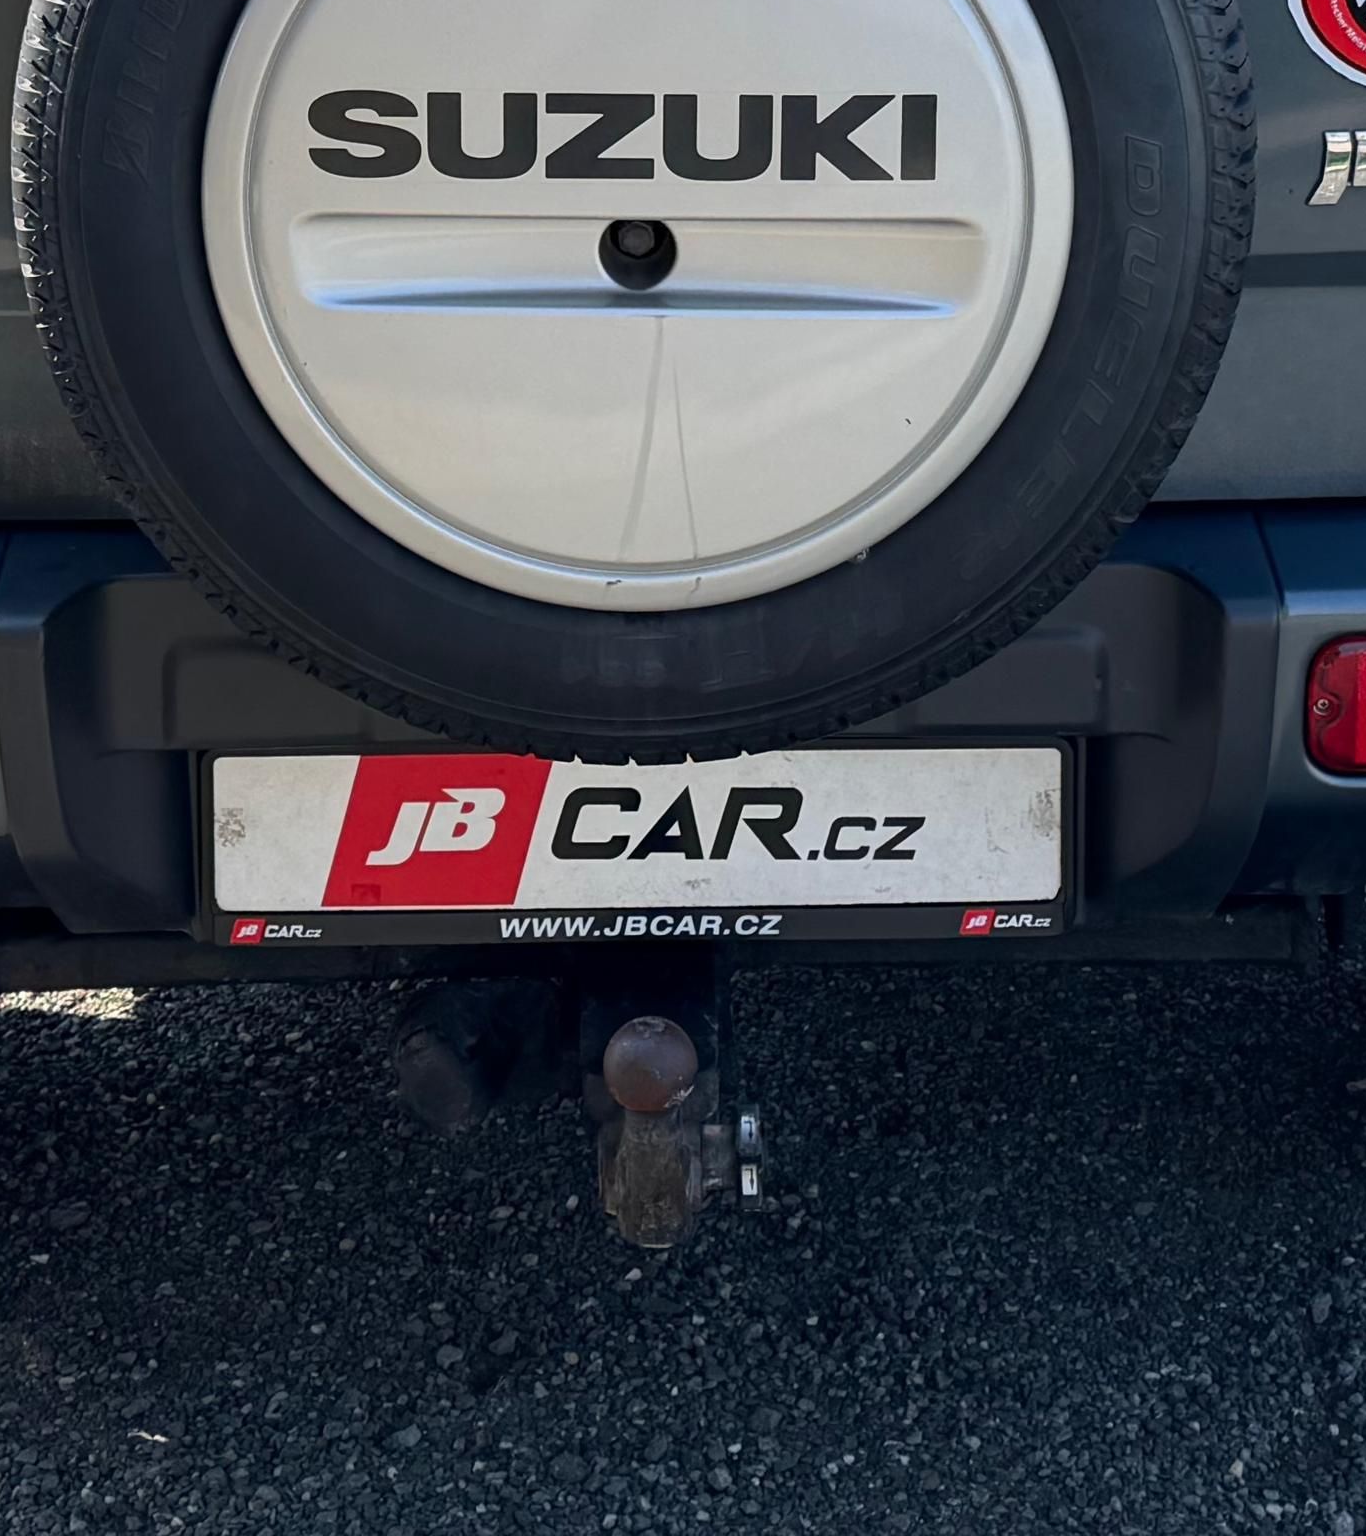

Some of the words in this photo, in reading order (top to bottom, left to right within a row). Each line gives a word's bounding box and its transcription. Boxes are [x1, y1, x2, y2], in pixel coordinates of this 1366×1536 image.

[307, 89, 938, 182] SUZUKI
[365, 787, 507, 867] JB
[499, 914, 783, 939] WWW.JBCAR.CZ
